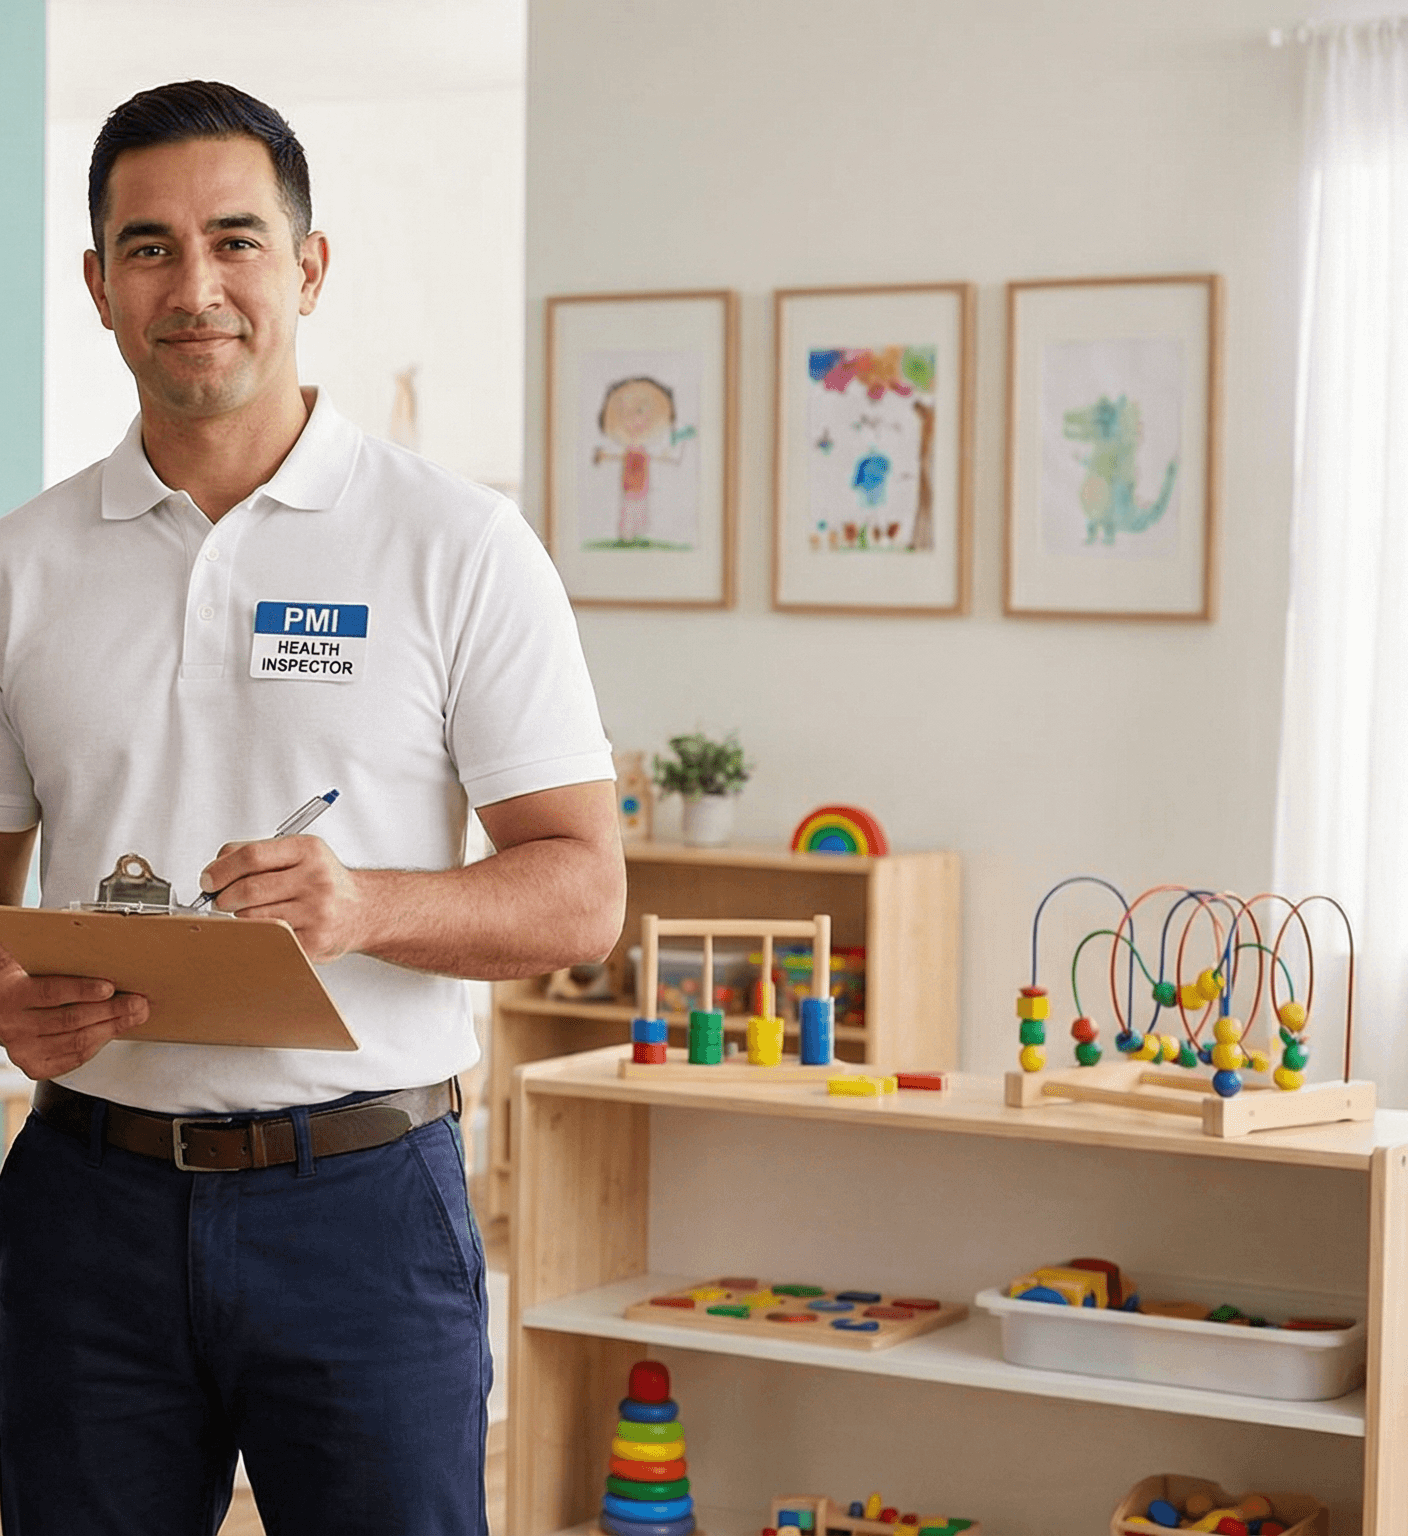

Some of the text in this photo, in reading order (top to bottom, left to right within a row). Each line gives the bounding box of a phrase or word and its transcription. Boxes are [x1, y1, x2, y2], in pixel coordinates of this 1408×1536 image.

[283, 607, 339, 633] PMI
[277, 640, 340, 656] HEALTH
[261, 657, 353, 675] INSPECTOR
